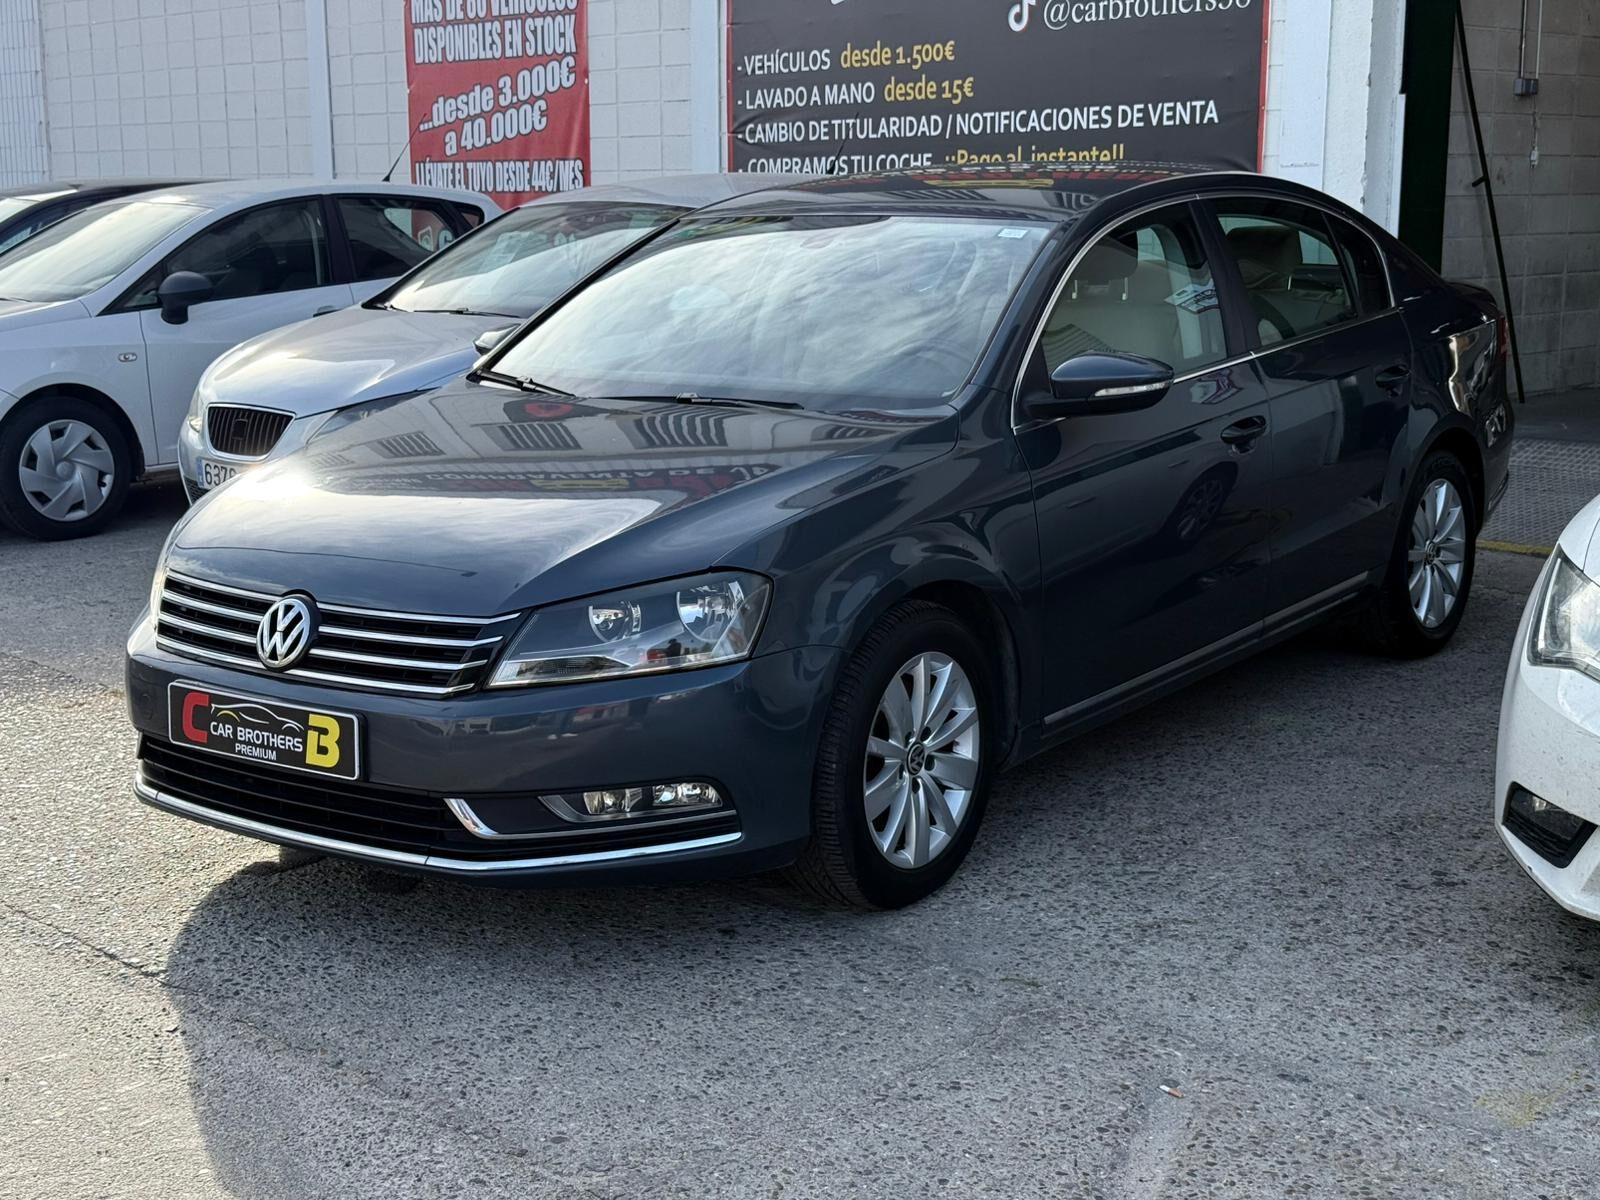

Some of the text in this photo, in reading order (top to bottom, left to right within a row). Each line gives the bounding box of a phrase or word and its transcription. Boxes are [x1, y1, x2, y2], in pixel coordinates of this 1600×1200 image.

[414, 14, 577, 64] DISPONIBLES EN STOCK
[744, 40, 956, 76] VEHÍCULOS desde 1.500€
[498, 56, 576, 107] 3.000€
[746, 73, 975, 110] LAVADO A MANO desde 15€
[444, 99, 548, 157] a 40.000€
[745, 120, 806, 144] CAMBIO
[809, 119, 830, 141] DE
[832, 114, 942, 140] TITULARIDAD
[956, 105, 1112, 135] NOTIFICACIONES
[1117, 103, 1145, 128] DE
[1148, 100, 1219, 126] VENTA
[466, 160, 494, 192] TUYO
[495, 160, 530, 192] DESDE
[531, 159, 584, 193] 44€/MES
[850, 154, 873, 174] TU
[210, 721, 303, 752] CAR BROTHERS
[235, 743, 276, 761] PREMIUM
